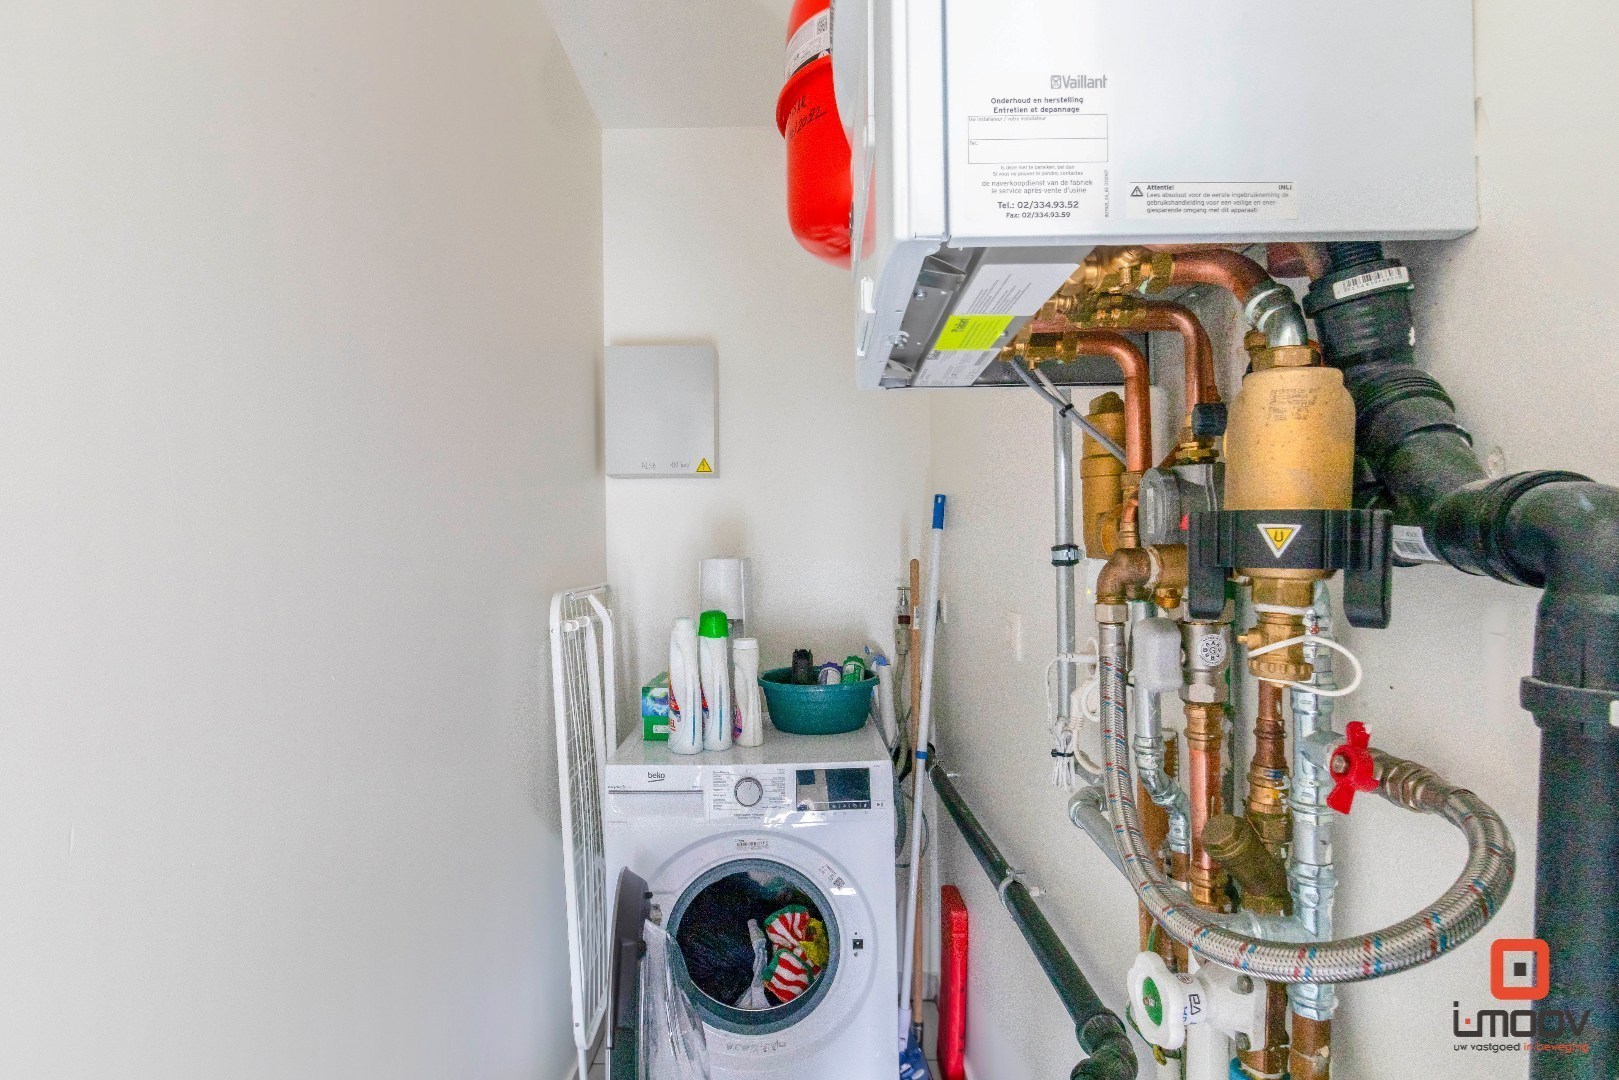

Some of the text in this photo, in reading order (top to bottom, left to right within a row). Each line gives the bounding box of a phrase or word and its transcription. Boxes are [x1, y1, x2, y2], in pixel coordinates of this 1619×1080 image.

[1062, 74, 1108, 89] Vaillant
[1044, 96, 1084, 104] herstelling
[997, 201, 1079, 209] Tel.: 02/334.93.52
[647, 771, 665, 779] beko
